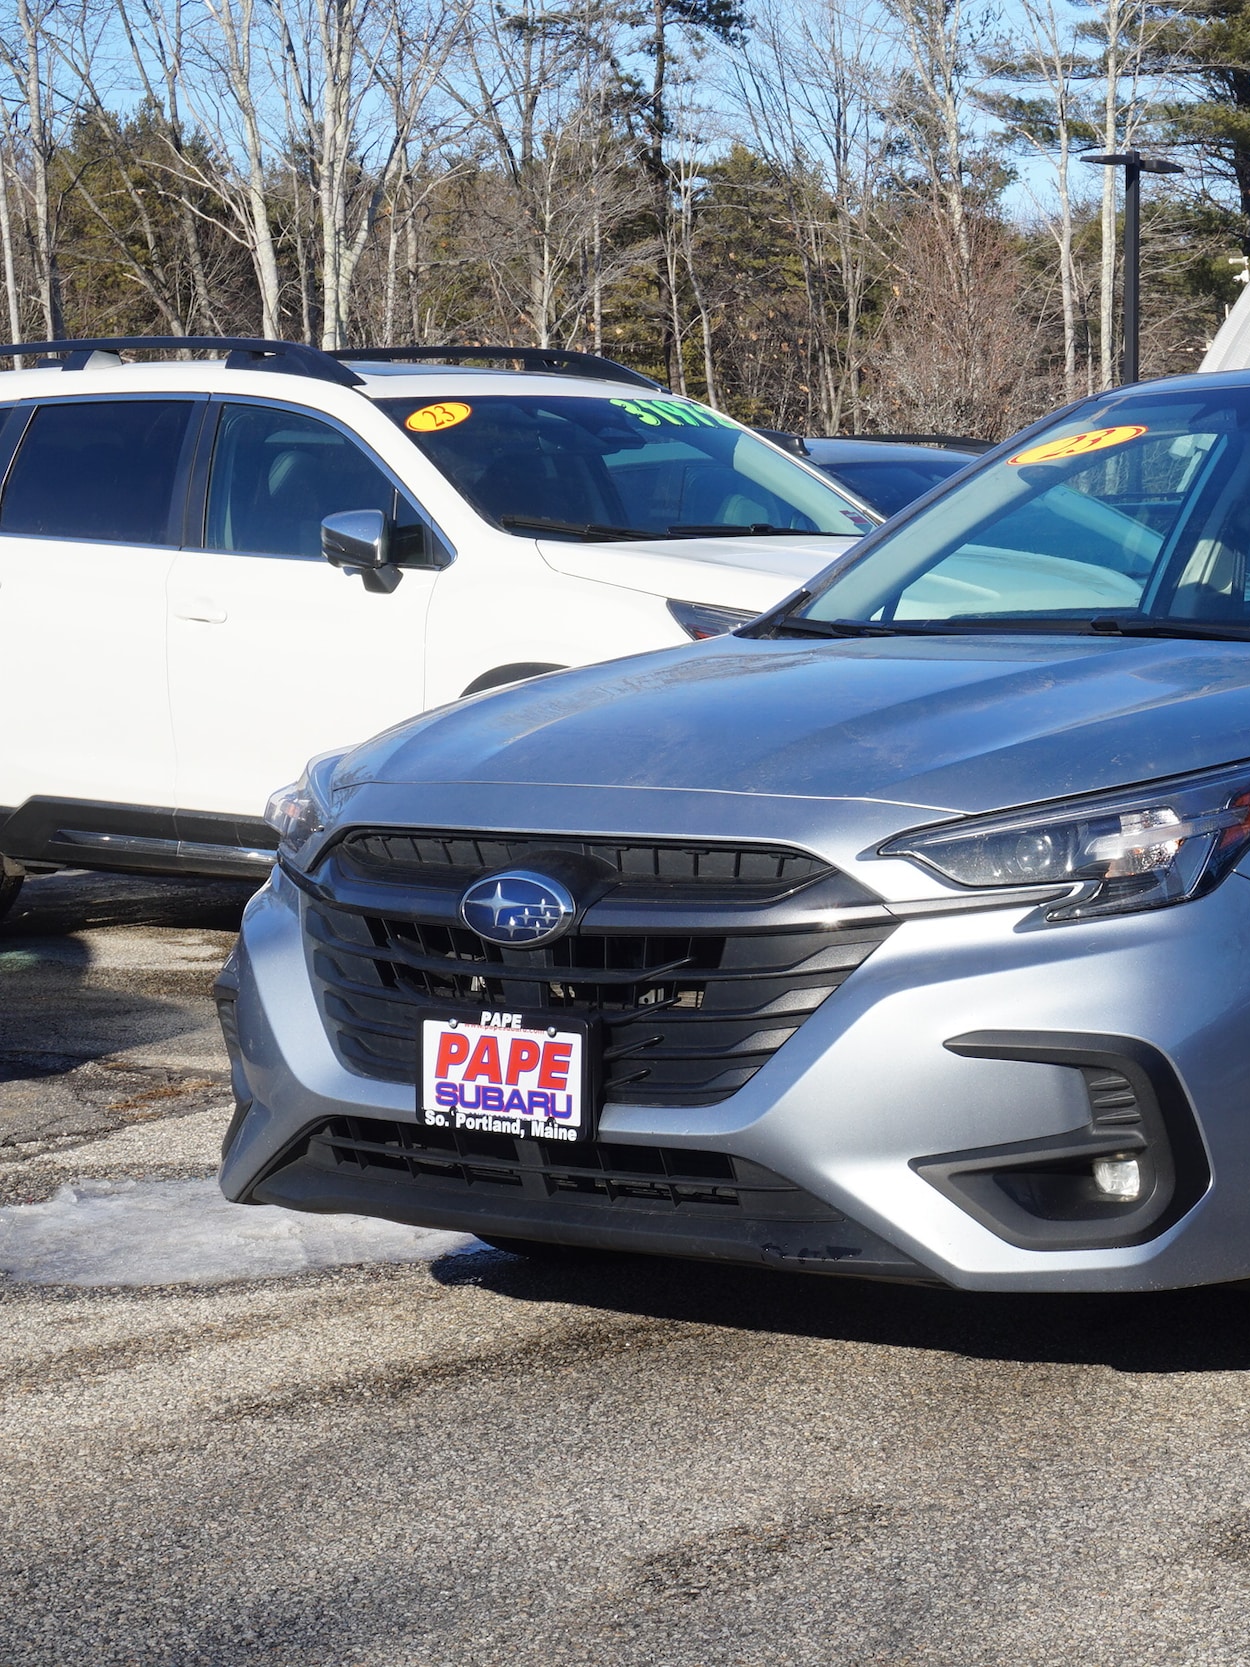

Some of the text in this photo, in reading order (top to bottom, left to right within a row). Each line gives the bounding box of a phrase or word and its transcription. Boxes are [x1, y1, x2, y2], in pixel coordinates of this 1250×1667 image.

[422, 405, 456, 427] 23
[480, 1011, 522, 1028] PAPE
[434, 1031, 573, 1091] PAPE
[435, 1081, 573, 1120] SUBARU
[424, 1110, 449, 1127] So.
[455, 1113, 525, 1139] Portland,
[531, 1120, 578, 1142] Maine
